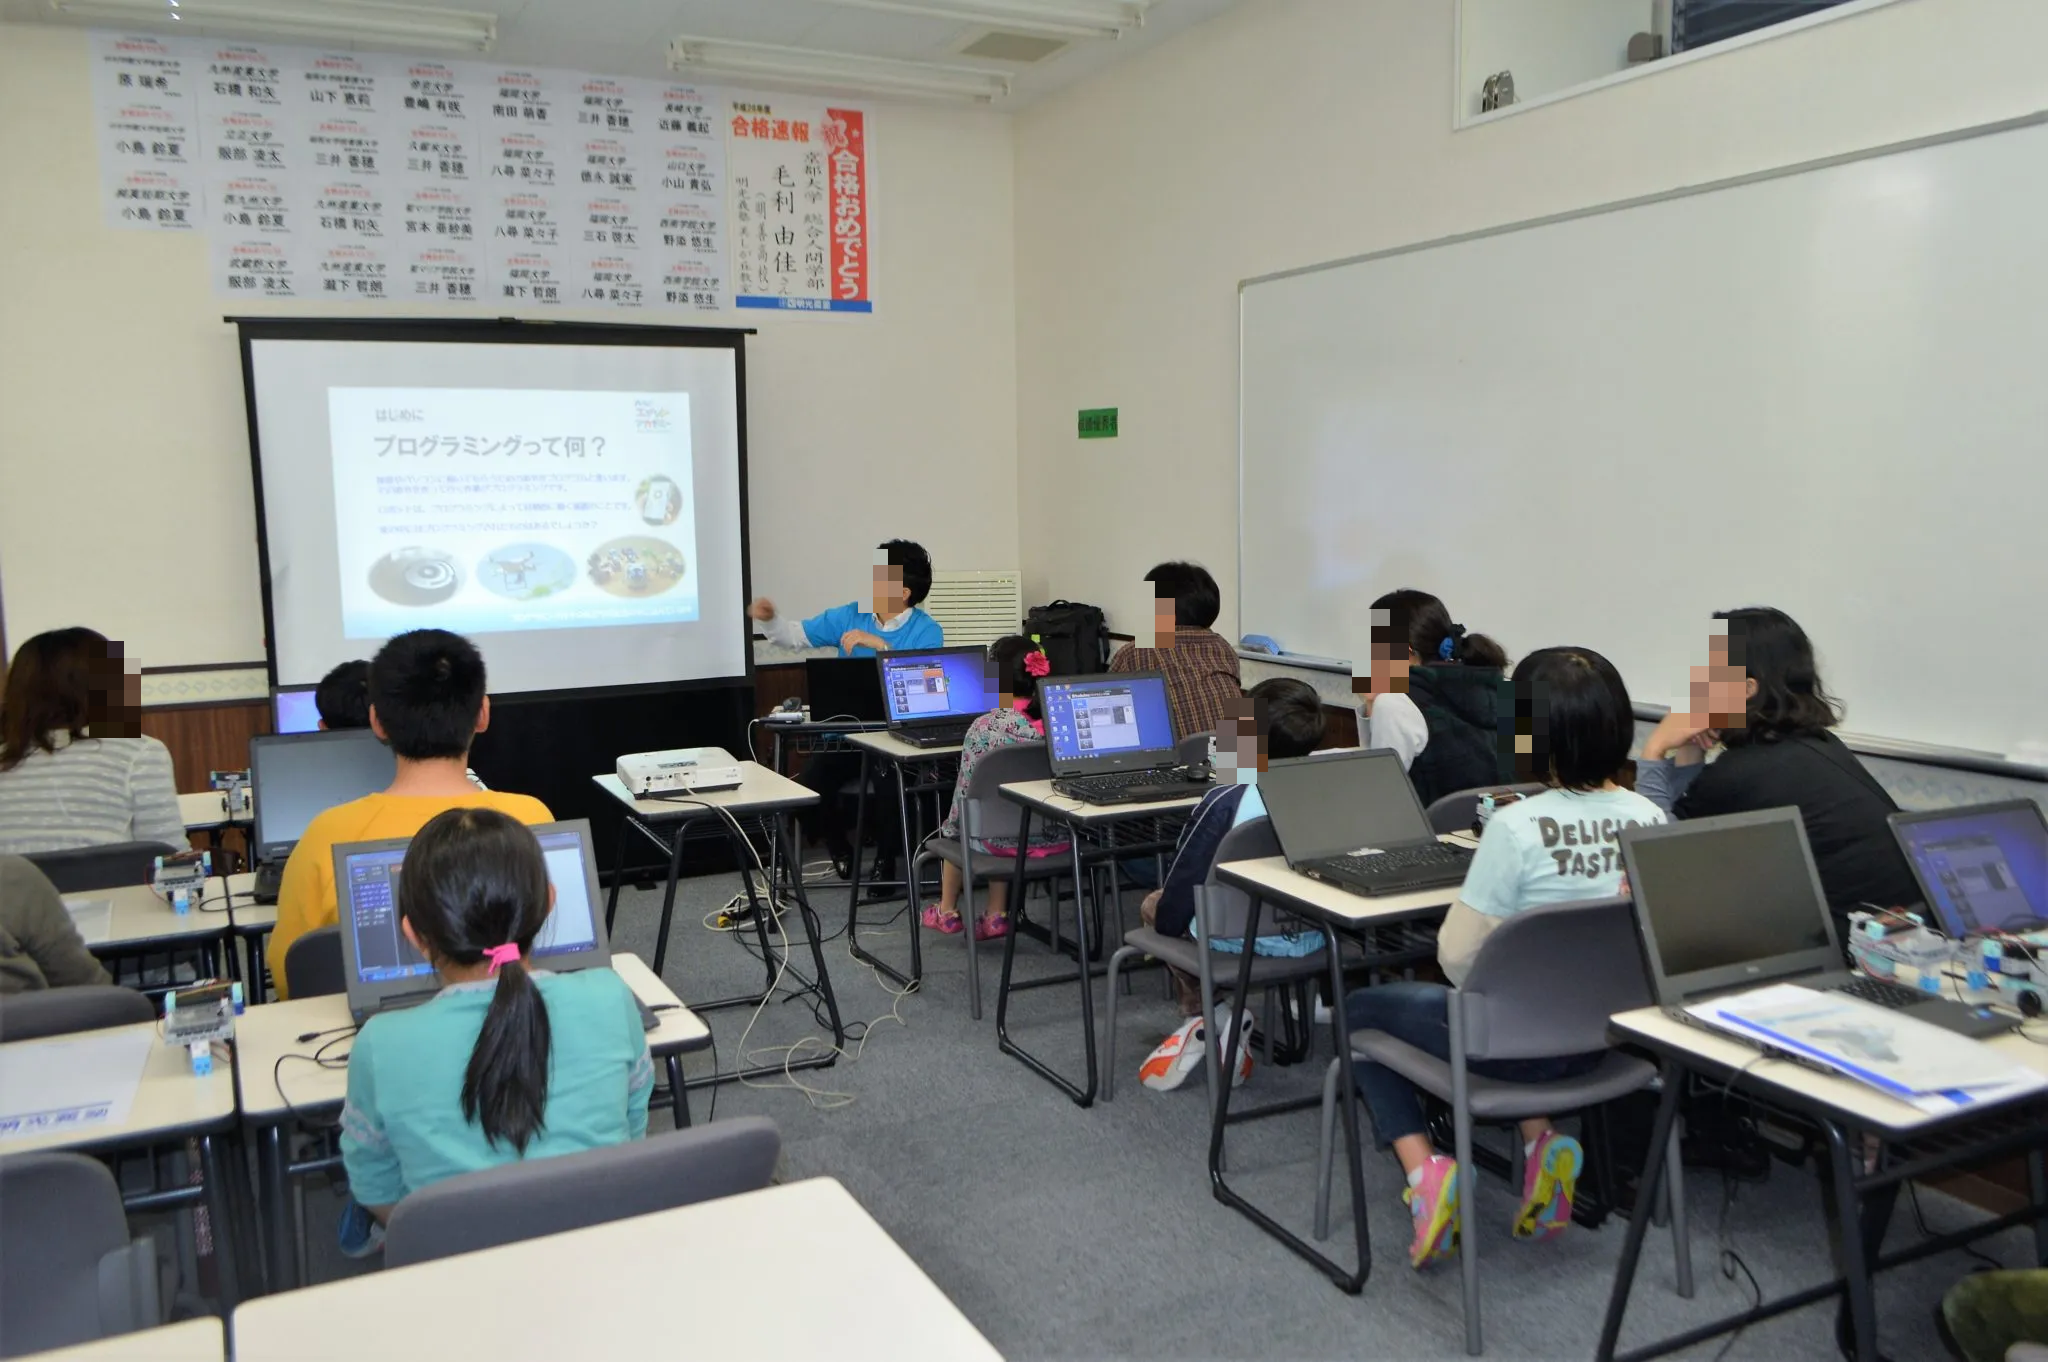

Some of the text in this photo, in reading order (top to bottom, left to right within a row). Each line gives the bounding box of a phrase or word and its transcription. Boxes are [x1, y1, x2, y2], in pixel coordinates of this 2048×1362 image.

[731, 114, 809, 143] 合格速報
[771, 164, 796, 214] 毛利
[833, 149, 862, 300] 合格おめでとう
[774, 225, 798, 273] 由佳
[375, 408, 425, 423] はじめに
[1530, 814, 1661, 848] "DELIC"
